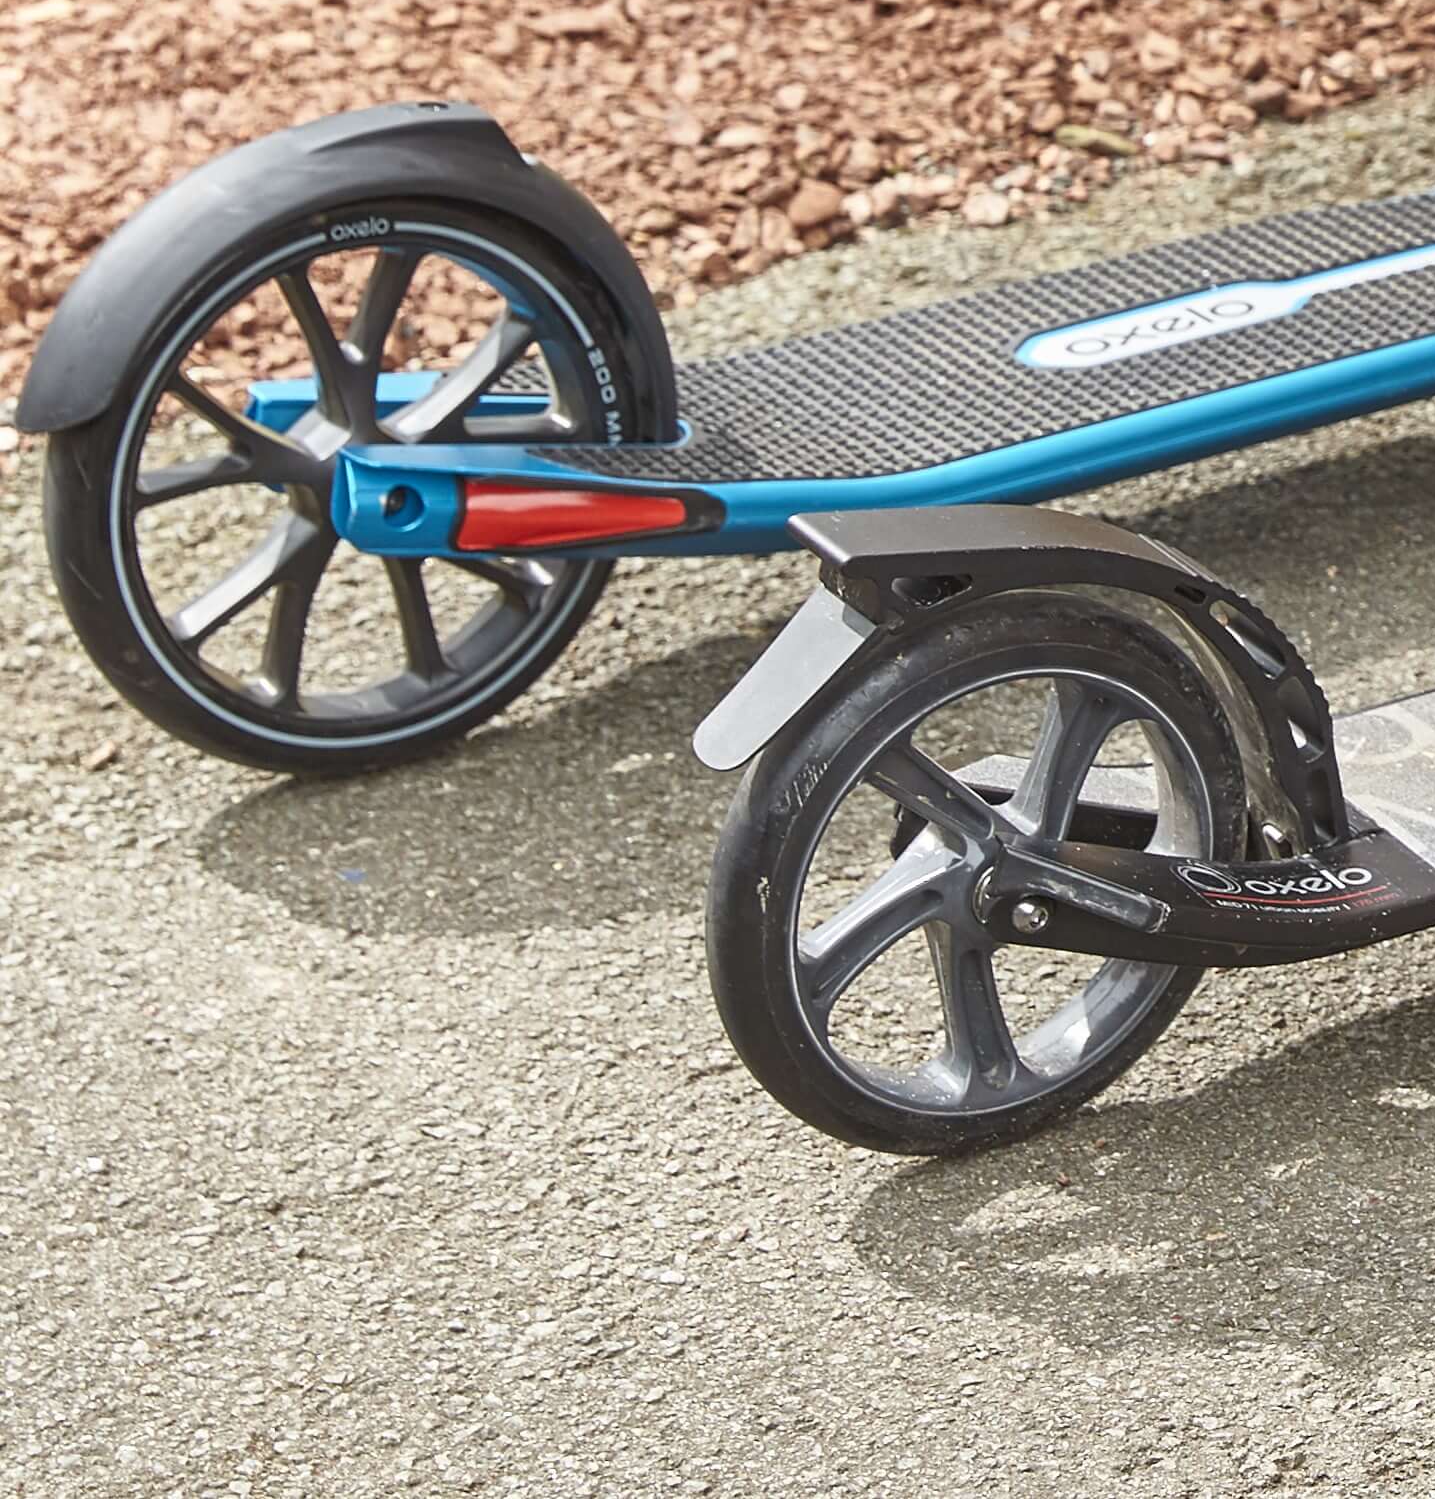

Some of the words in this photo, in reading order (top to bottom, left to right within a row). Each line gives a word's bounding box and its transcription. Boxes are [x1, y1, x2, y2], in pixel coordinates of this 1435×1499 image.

[330, 216, 390, 241] oxelo
[1065, 300, 1255, 358] oxelo
[1244, 867, 1372, 895] oxelo
